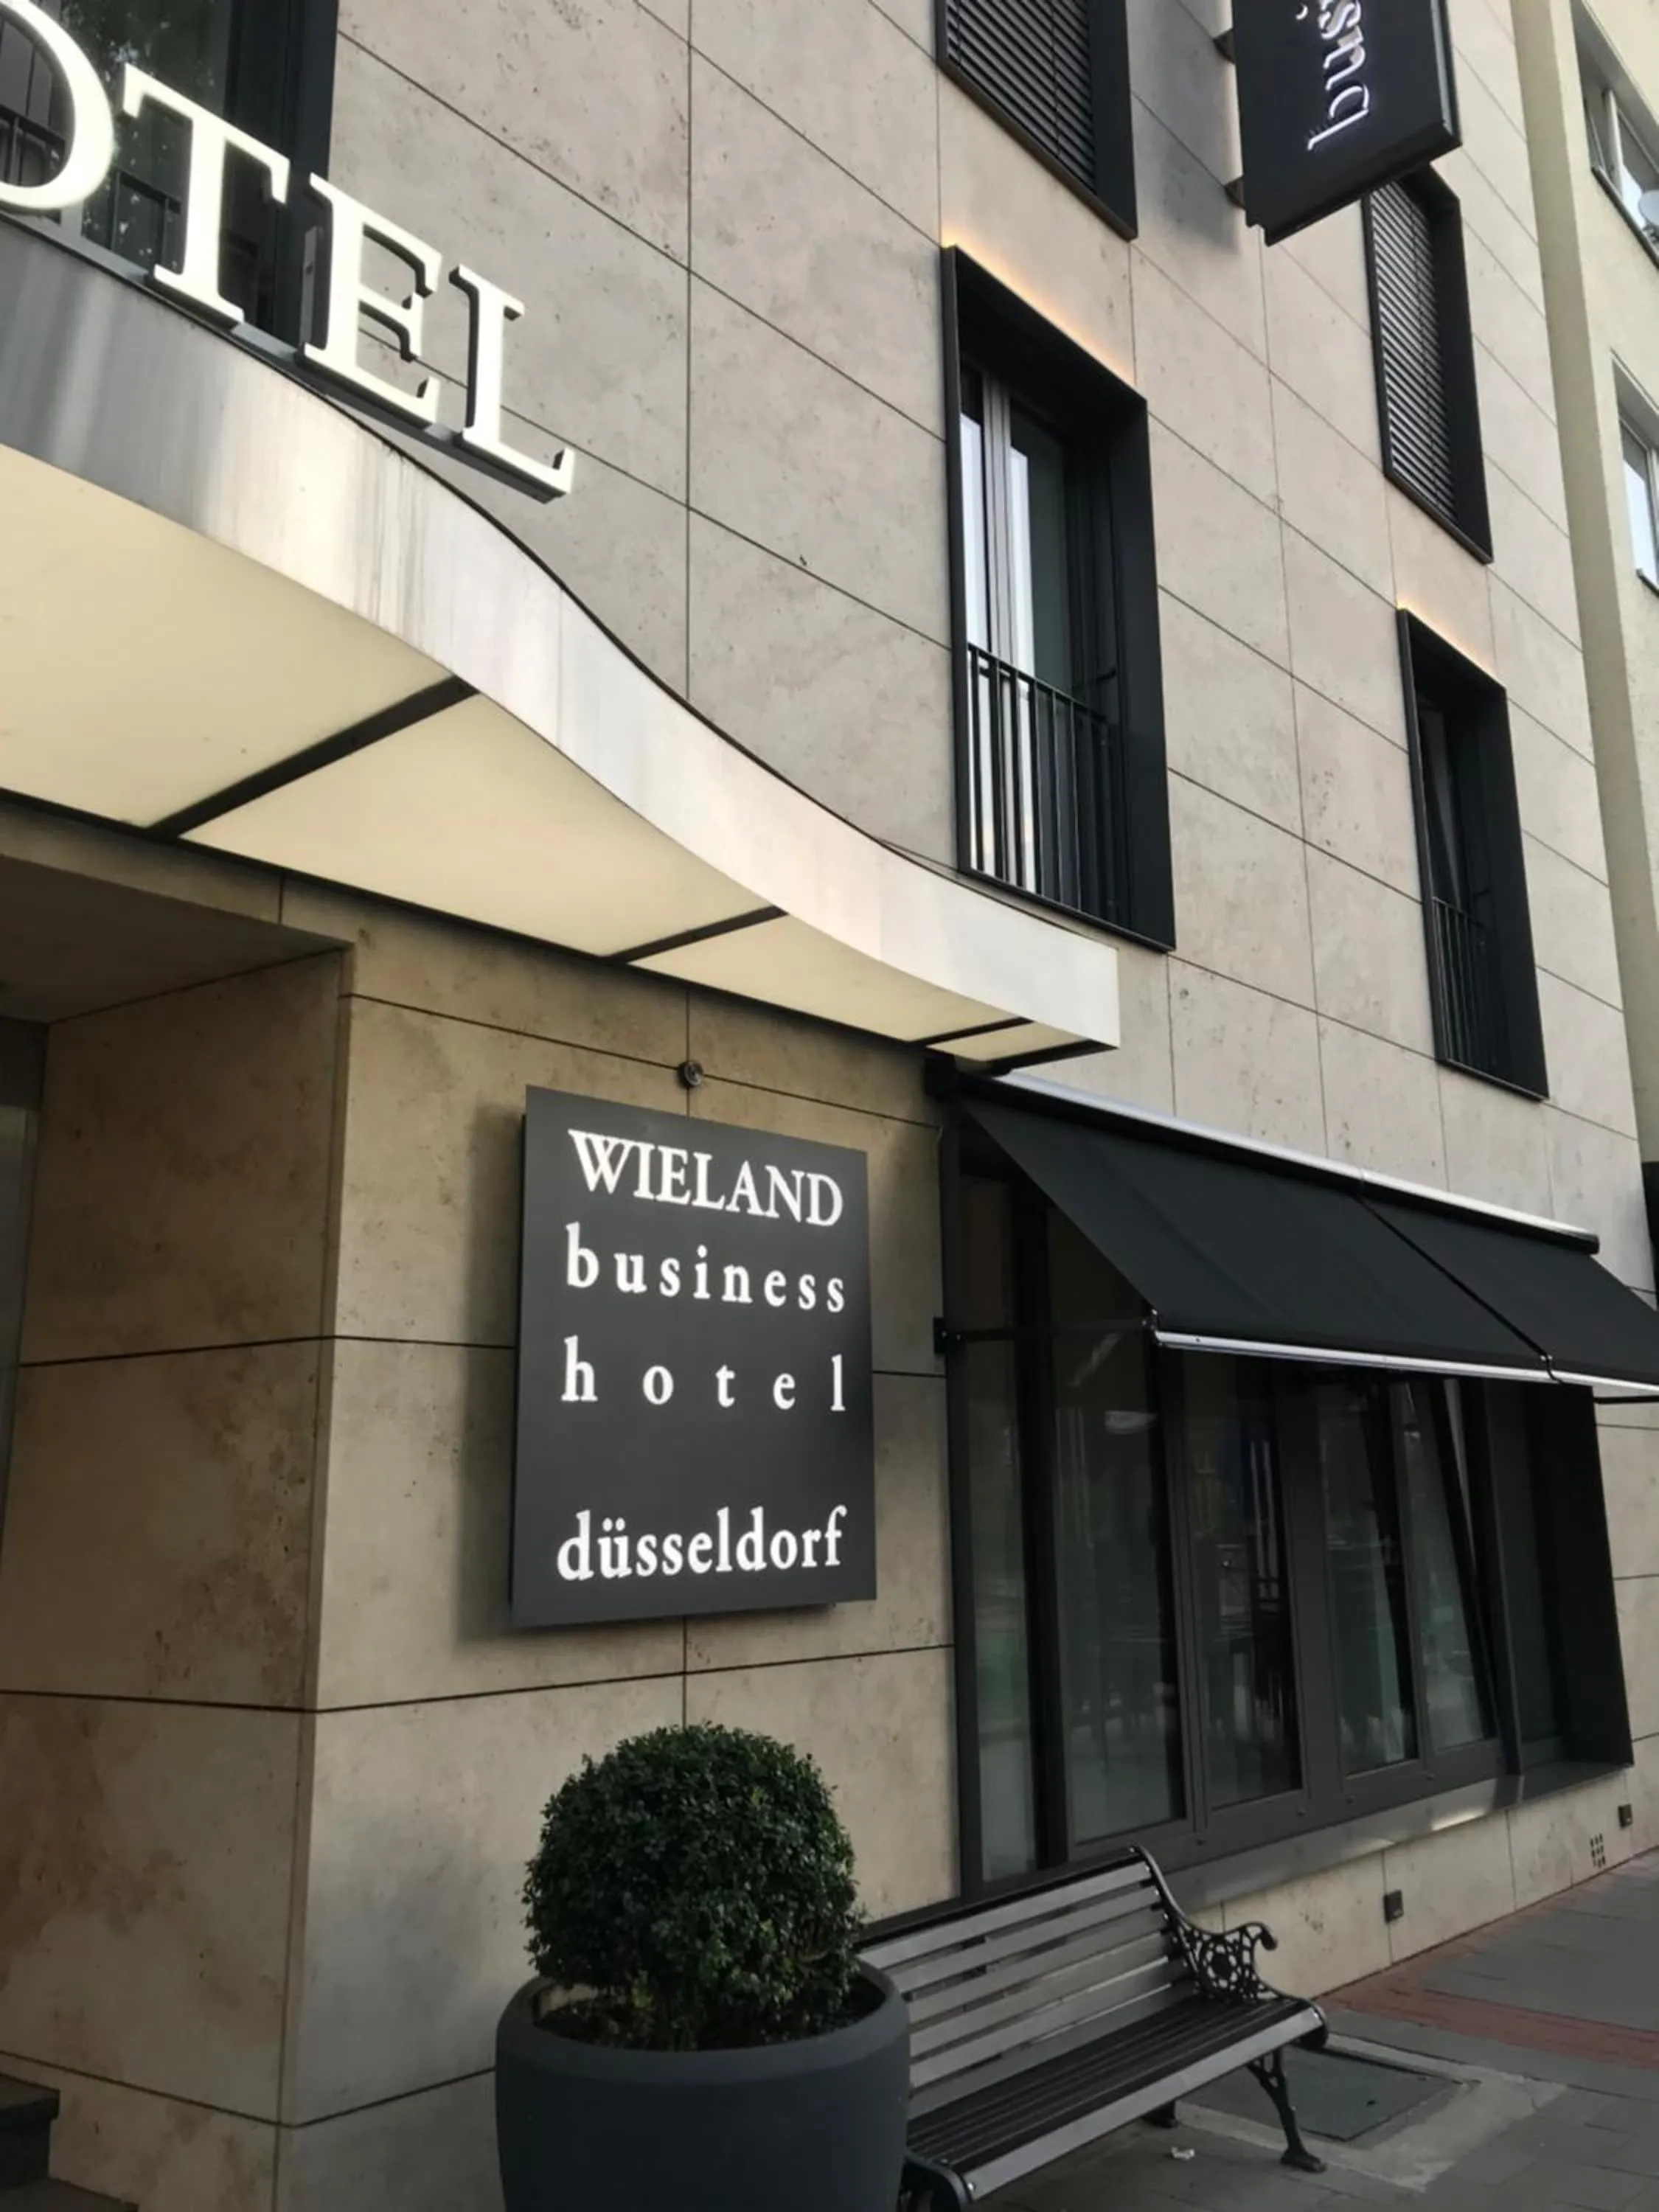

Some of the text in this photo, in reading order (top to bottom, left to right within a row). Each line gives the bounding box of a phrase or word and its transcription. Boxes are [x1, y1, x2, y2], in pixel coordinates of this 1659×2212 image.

[567, 1128, 844, 1227] WIELAND
[566, 1221, 845, 1313] business
[560, 1335, 846, 1412] hotel
[557, 1505, 848, 1582] düsseldorf
